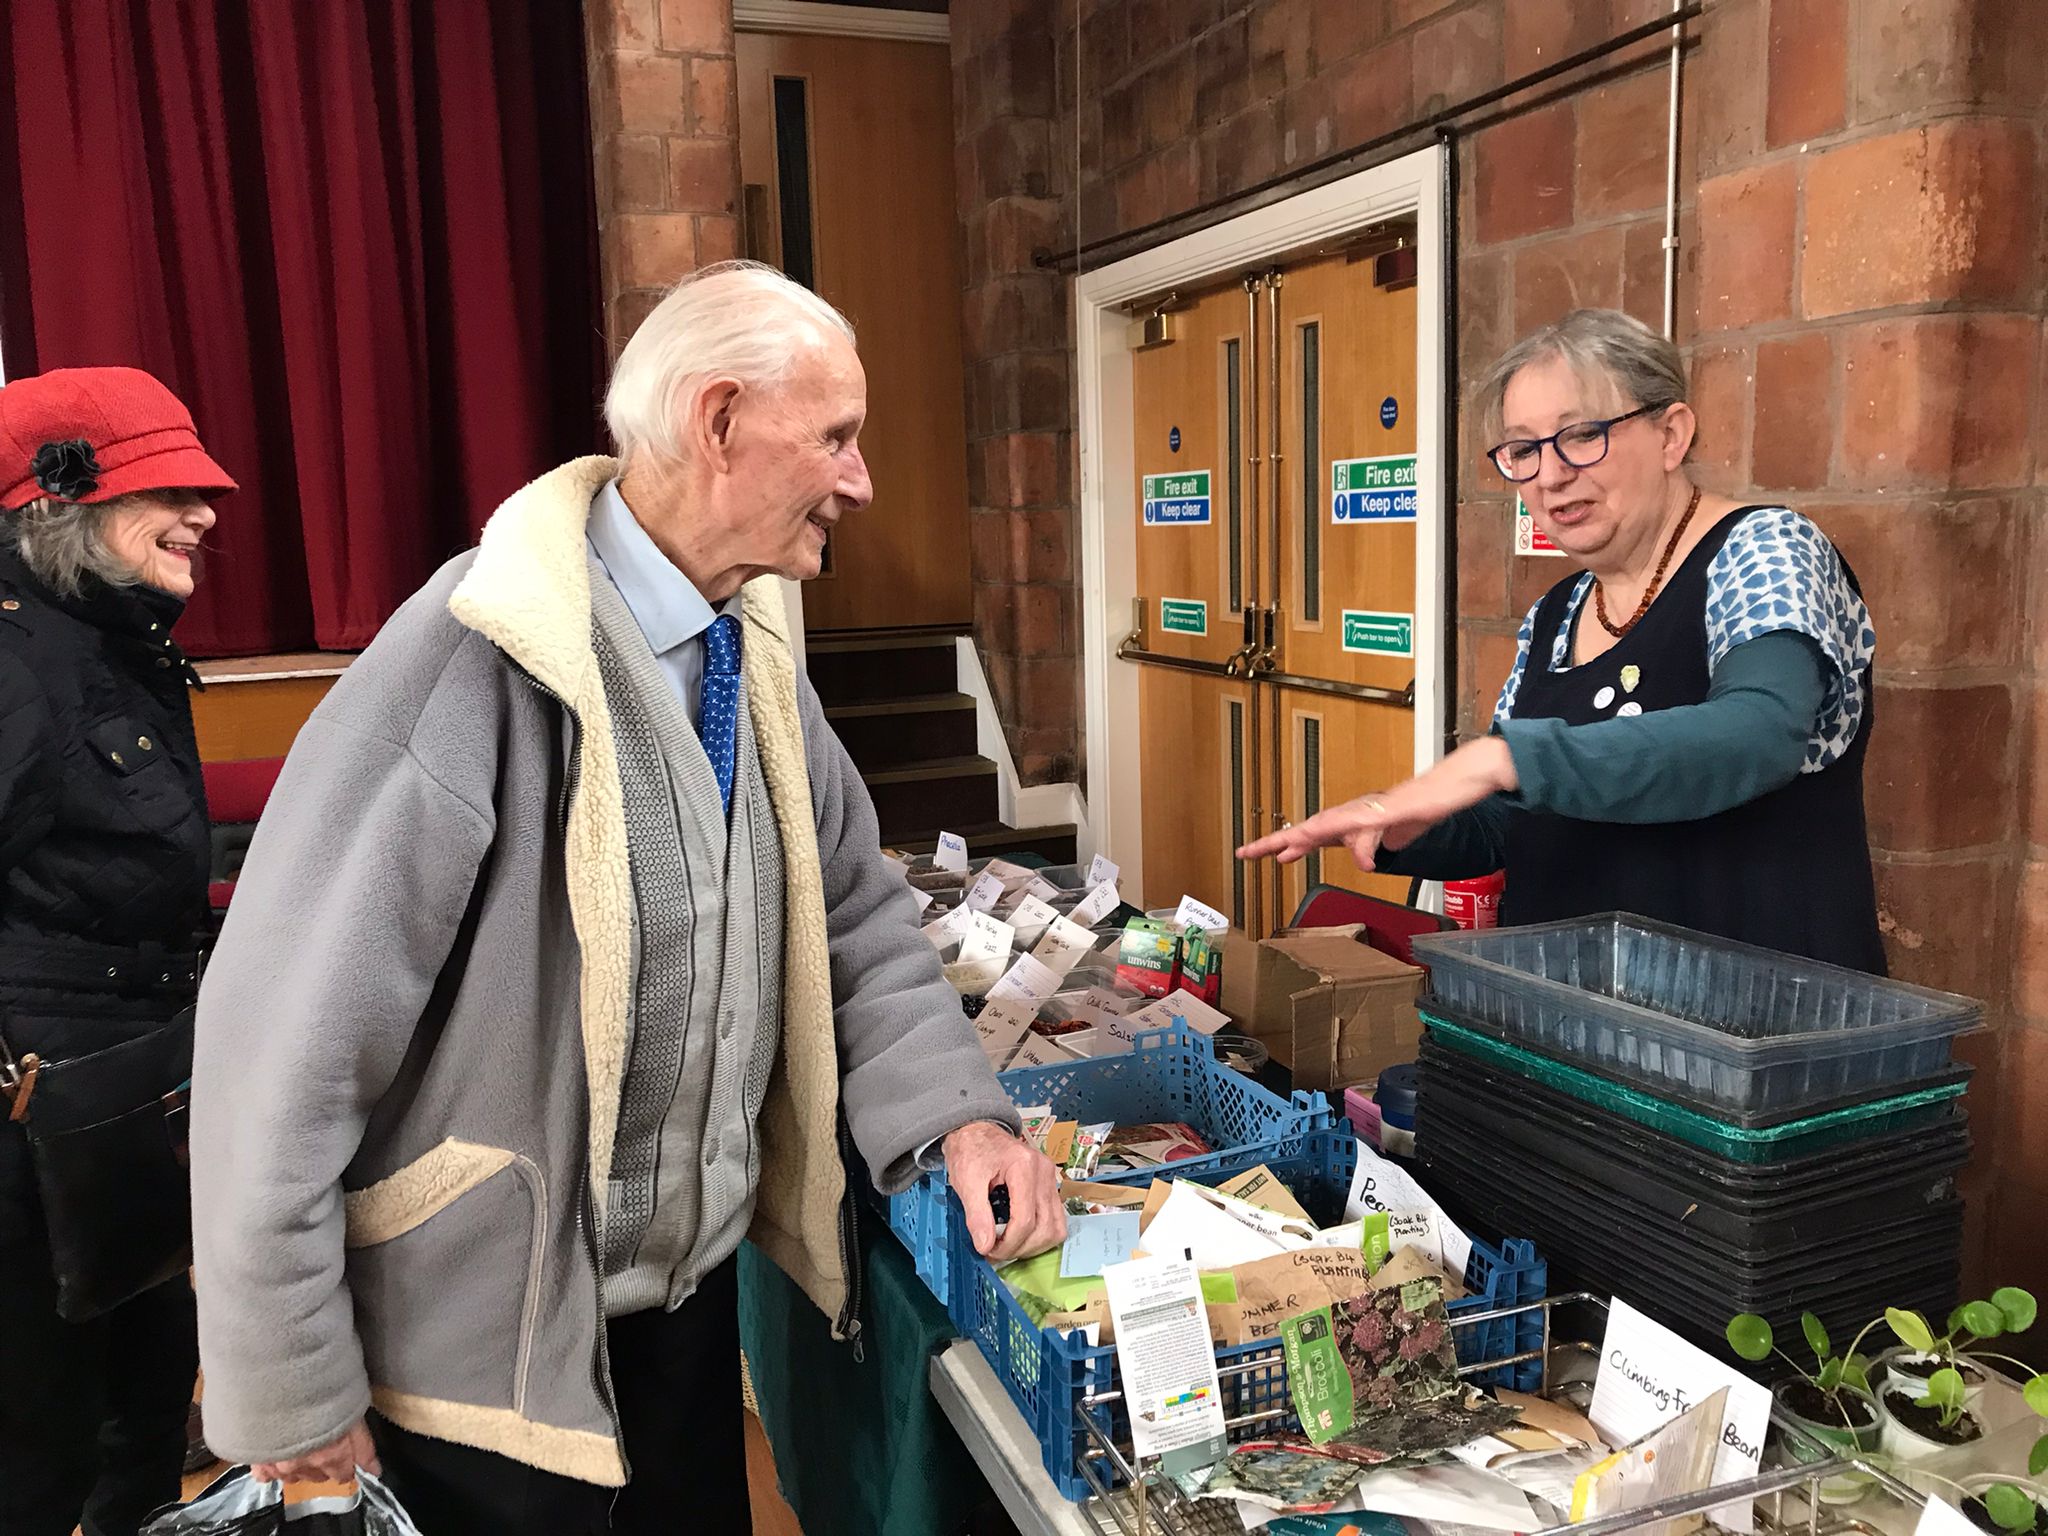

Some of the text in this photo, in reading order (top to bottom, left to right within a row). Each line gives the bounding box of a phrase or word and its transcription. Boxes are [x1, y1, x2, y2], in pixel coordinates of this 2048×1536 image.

[1366, 465, 1391, 485] Fire
[1164, 479, 1198, 495] Fire exit
[1161, 502, 1201, 518] Keep clear
[1361, 492, 1417, 516] Keep clea
[1357, 631, 1398, 644] Push bar to open
[1127, 955, 1162, 970] unwins
[1256, 1222, 1278, 1237] bean
[1336, 1251, 1355, 1264] B4
[1286, 1327, 1302, 1372] Morgan
[1311, 1348, 1329, 1401] Broccoli
[1609, 1349, 1671, 1412] Climbing
[1297, 1380, 1318, 1440] Thompson
[1722, 1422, 1760, 1463] Bean
